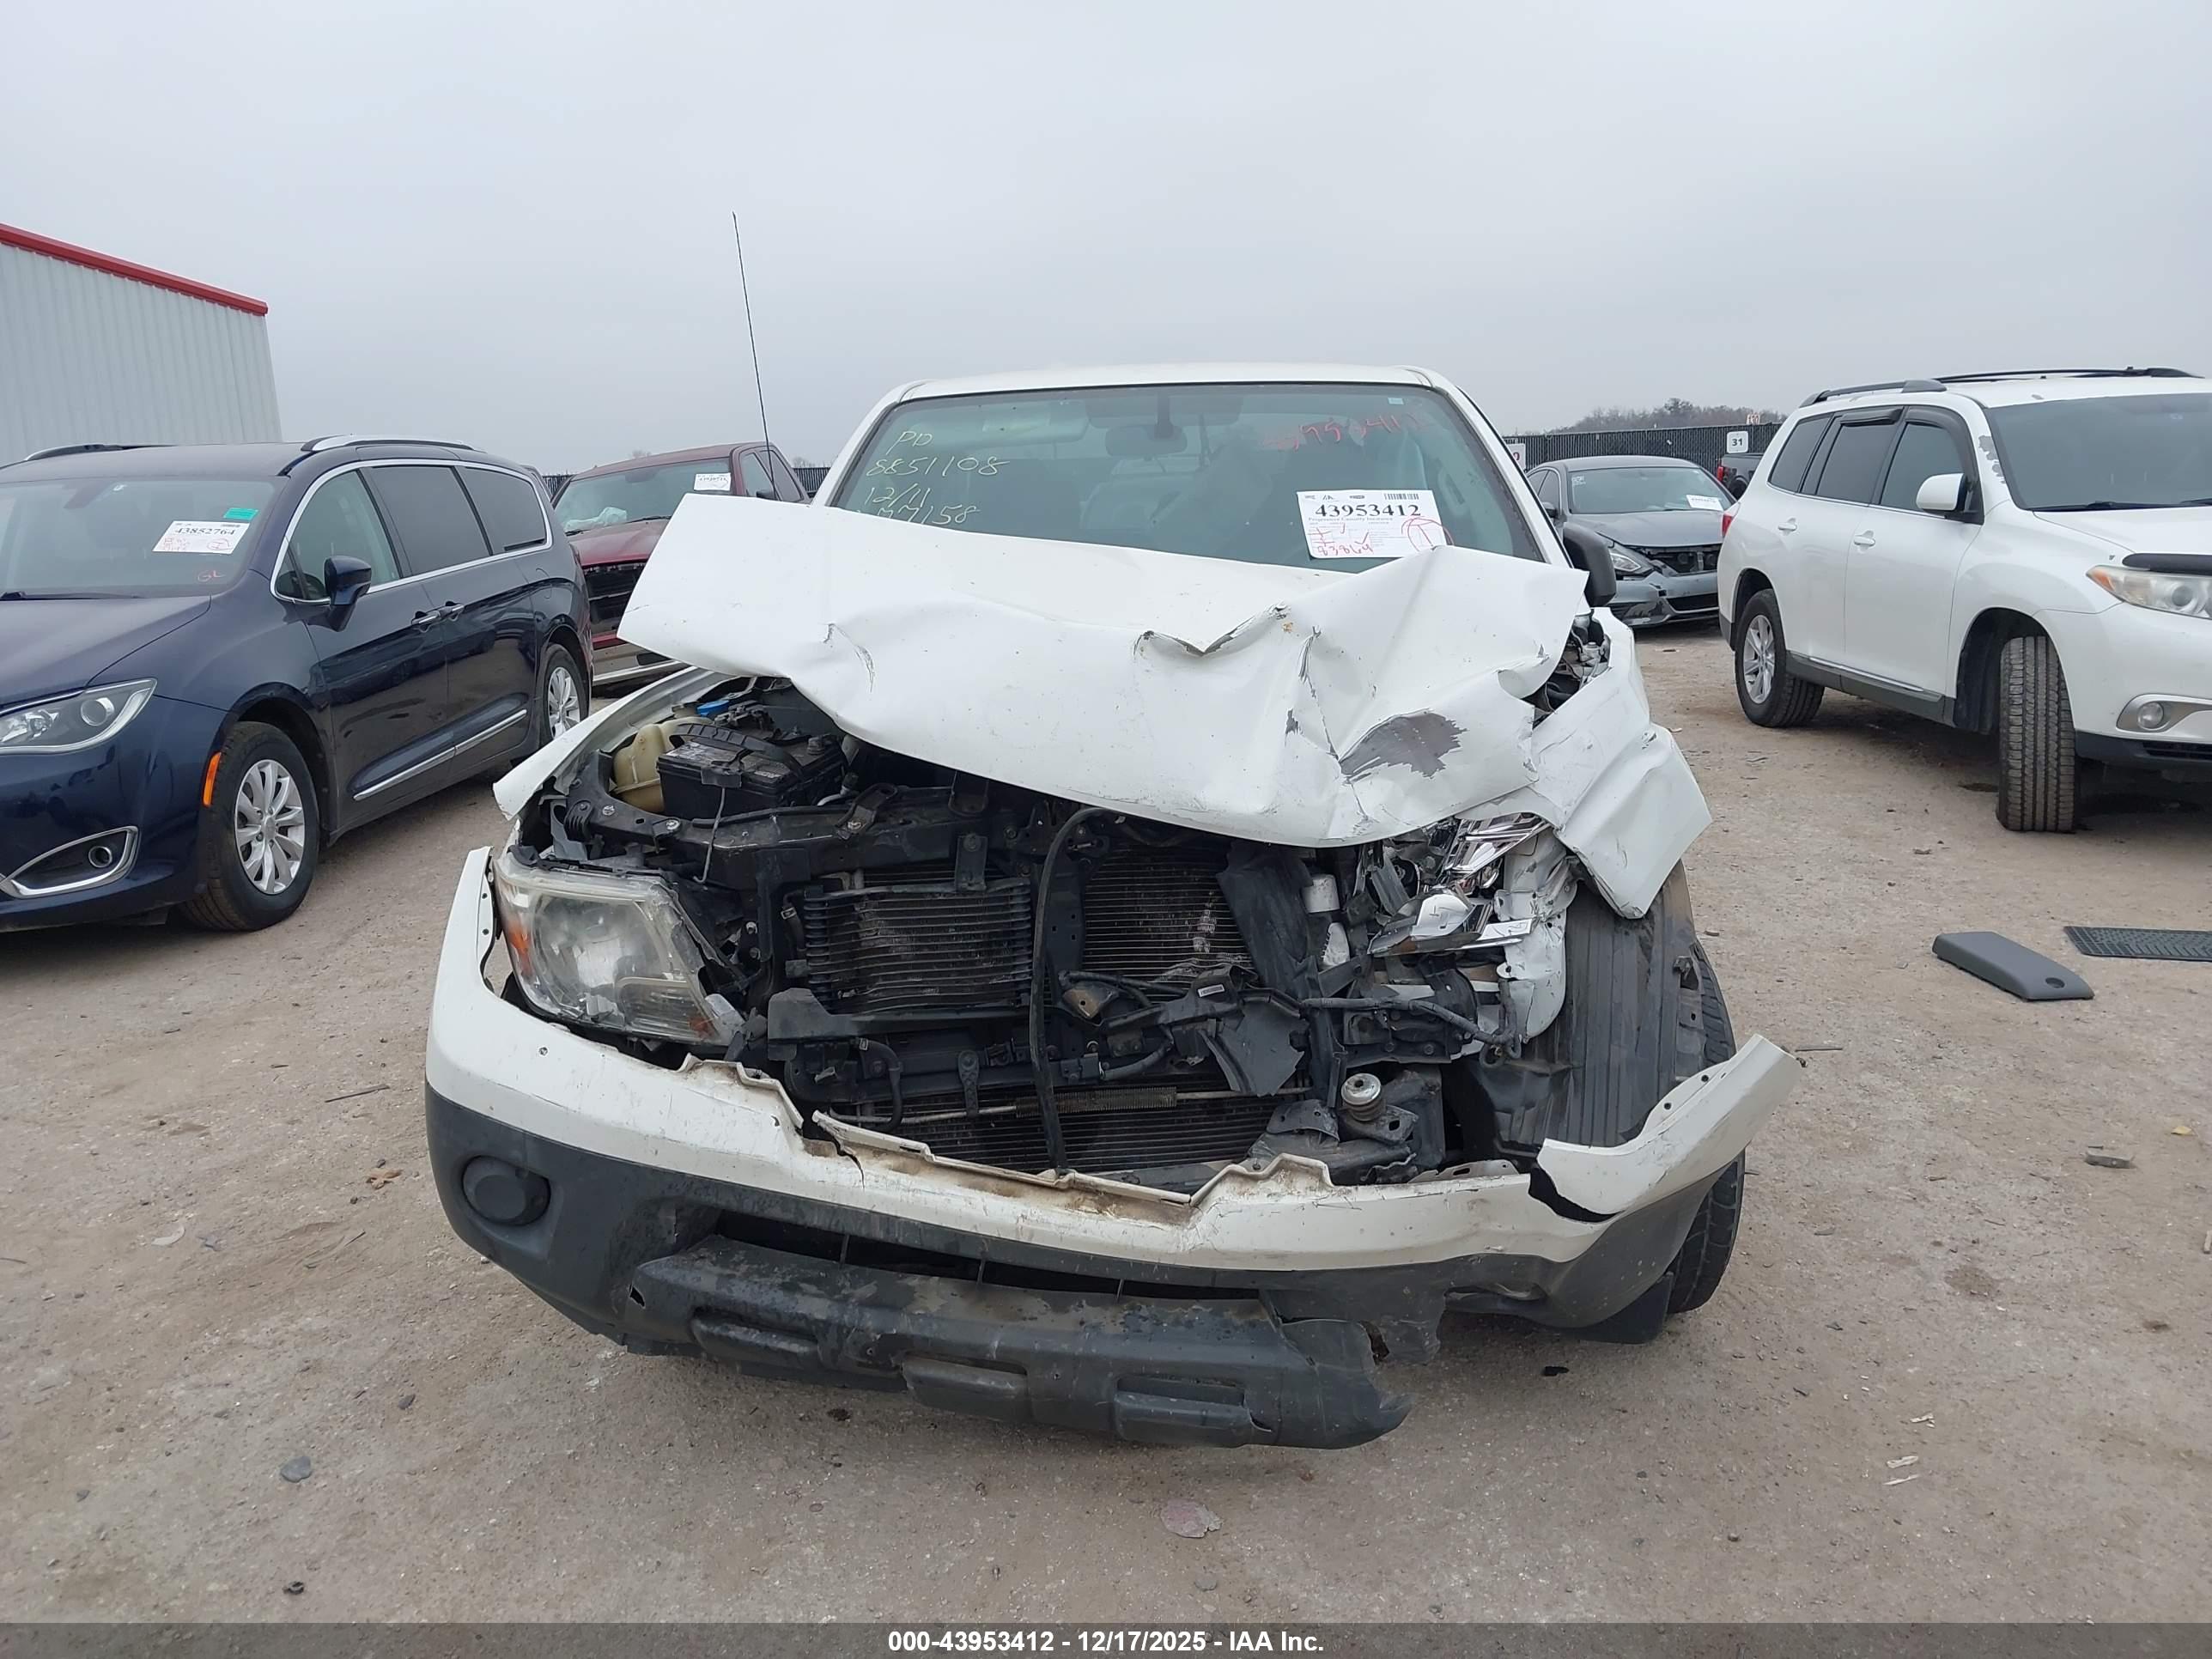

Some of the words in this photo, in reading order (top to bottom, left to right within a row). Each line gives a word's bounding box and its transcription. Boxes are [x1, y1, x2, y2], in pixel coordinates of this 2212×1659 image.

[1731, 438, 1743, 447] 31
[864, 483, 931, 507] 12/11
[1316, 503, 1422, 517] 43953412
[174, 527, 236, 536] 43852764
